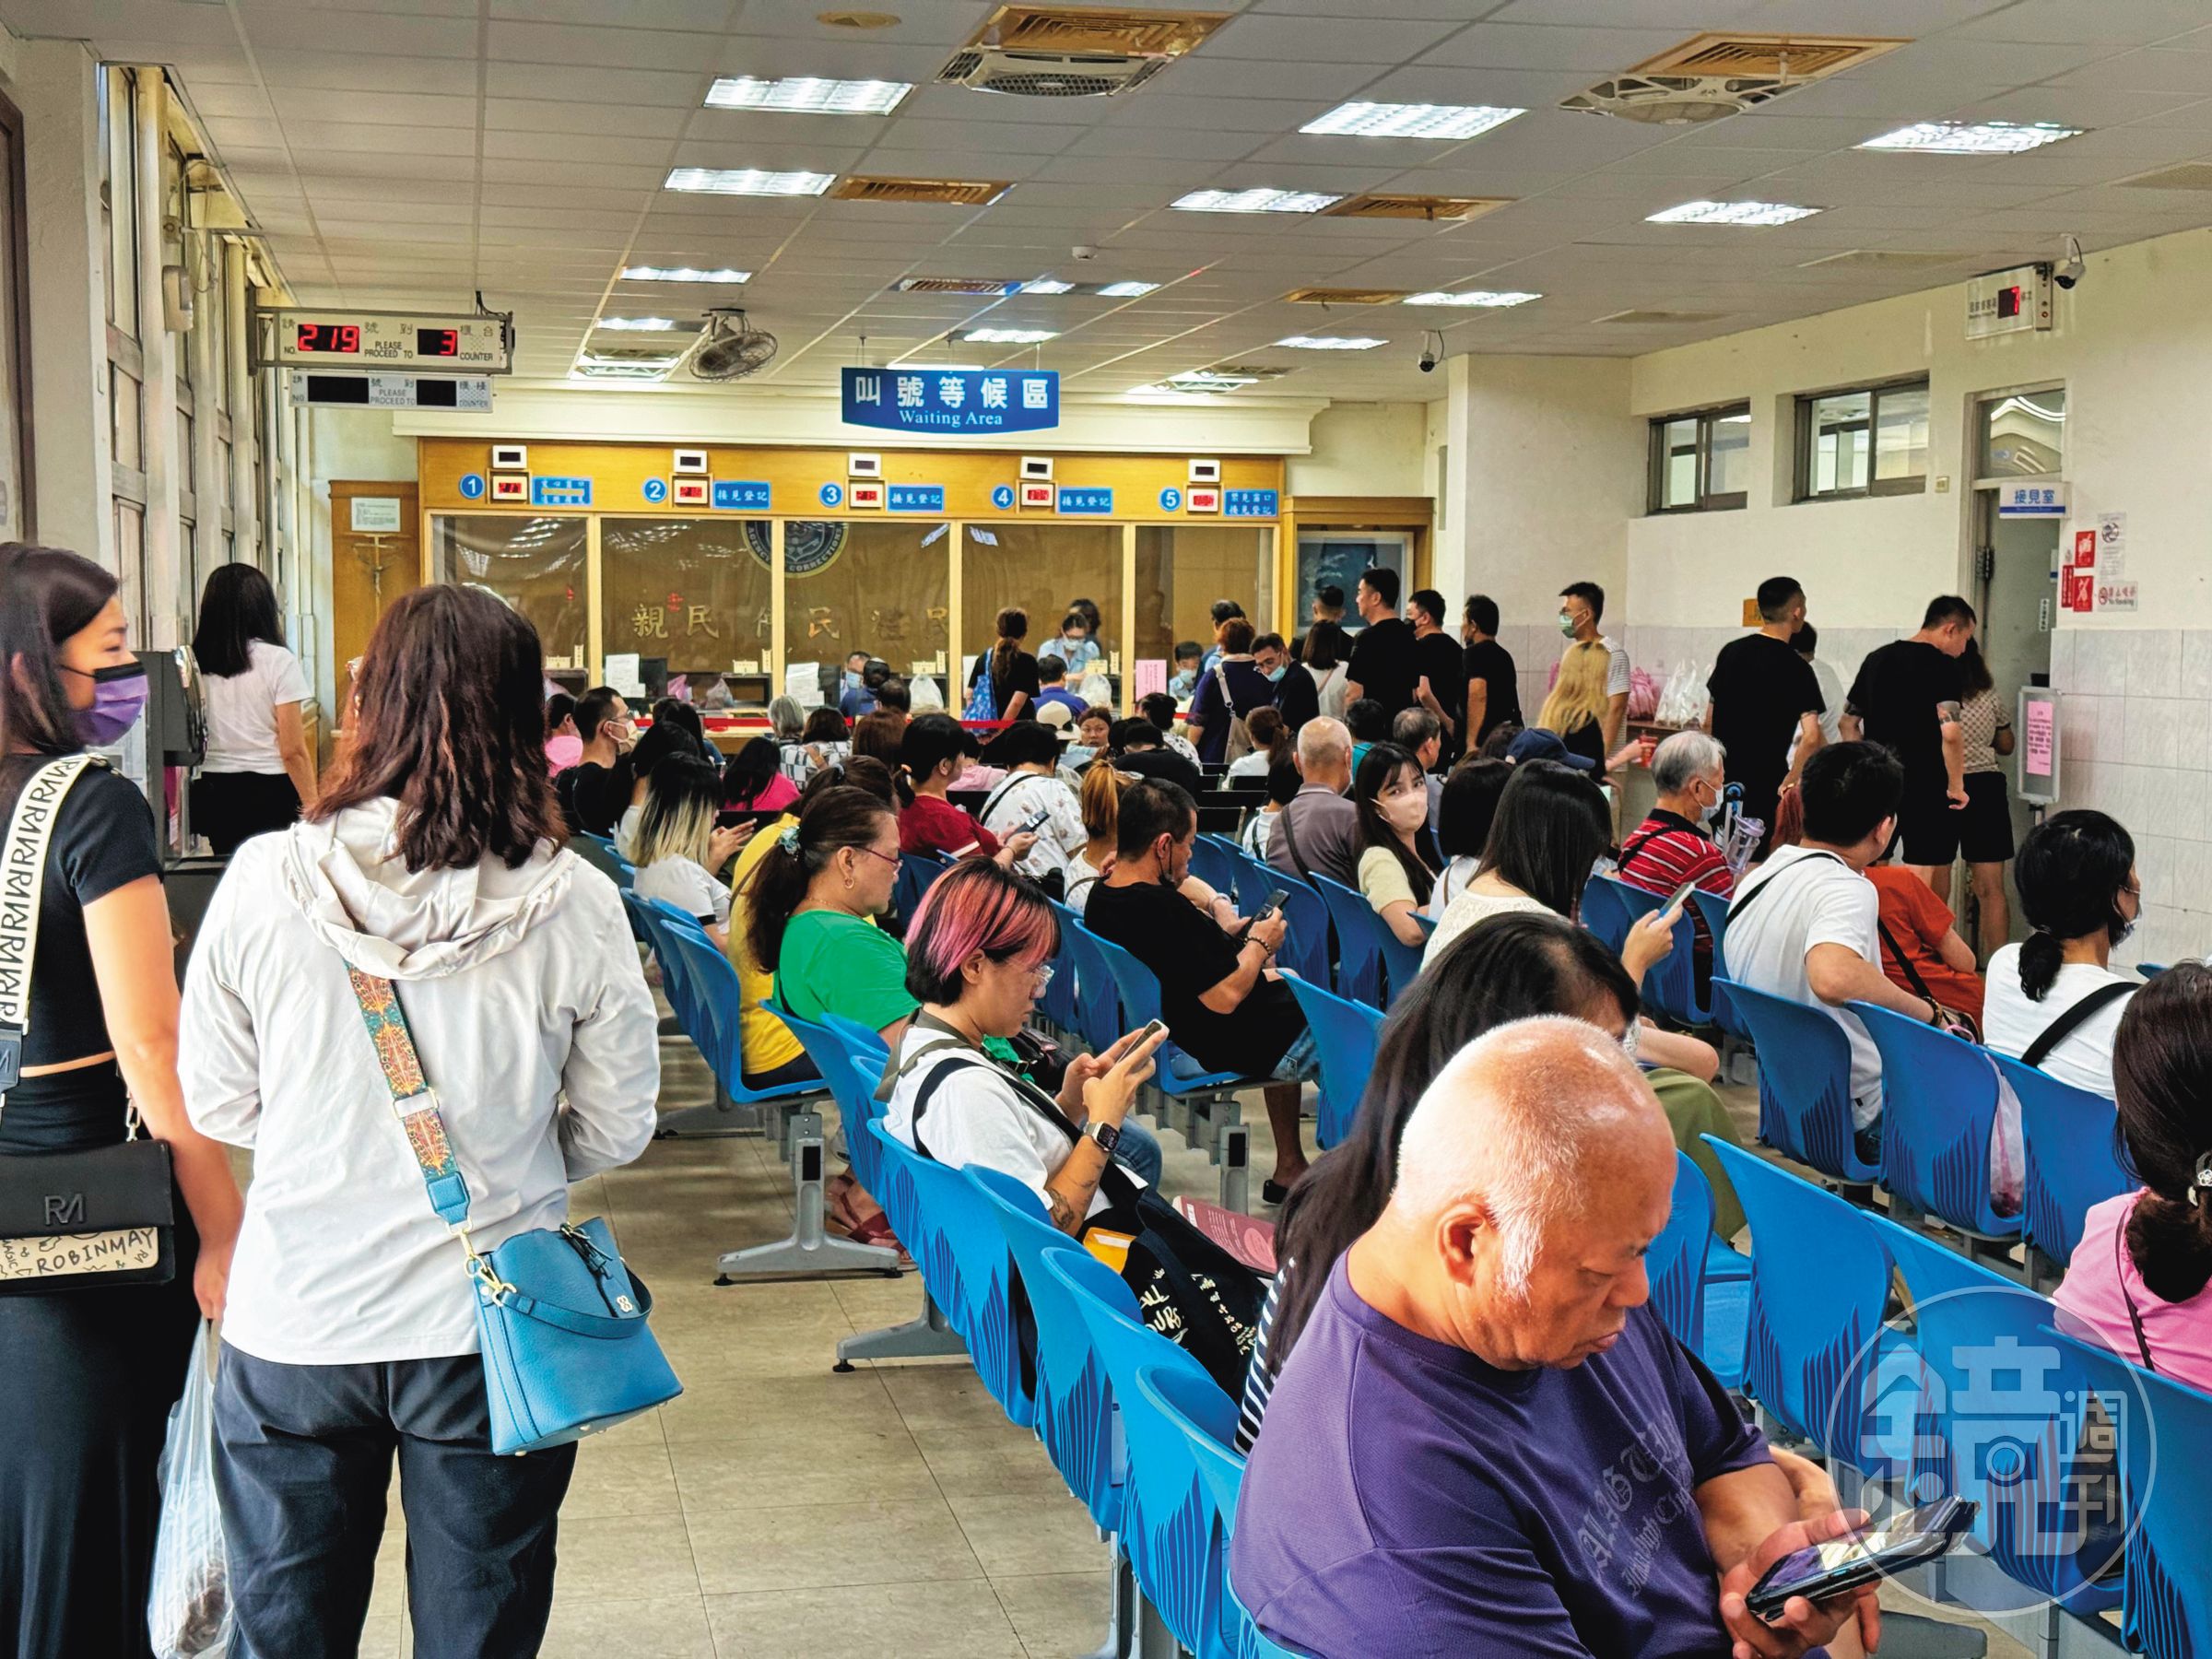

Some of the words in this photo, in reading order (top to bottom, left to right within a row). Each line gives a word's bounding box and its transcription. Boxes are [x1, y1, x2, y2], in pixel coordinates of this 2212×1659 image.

[298, 324, 359, 353] 219
[375, 341, 403, 350] PLEASE
[440, 330, 457, 356] 3
[364, 348, 398, 359] PROCEED
[404, 350, 414, 359] TO
[460, 352, 494, 361] COUNTER
[371, 396, 406, 406] PROCEED
[406, 397, 416, 406] TO
[379, 388, 406, 397] PLEASE
[855, 376, 1049, 409] 叫號等候區
[900, 410, 961, 428] Waiting
[965, 411, 1003, 426] Area
[2015, 489, 2055, 505] 接見室
[747, 525, 771, 562] AGENCY
[631, 603, 720, 640] 親民
[37, 1228, 154, 1276] ROBINMAY
